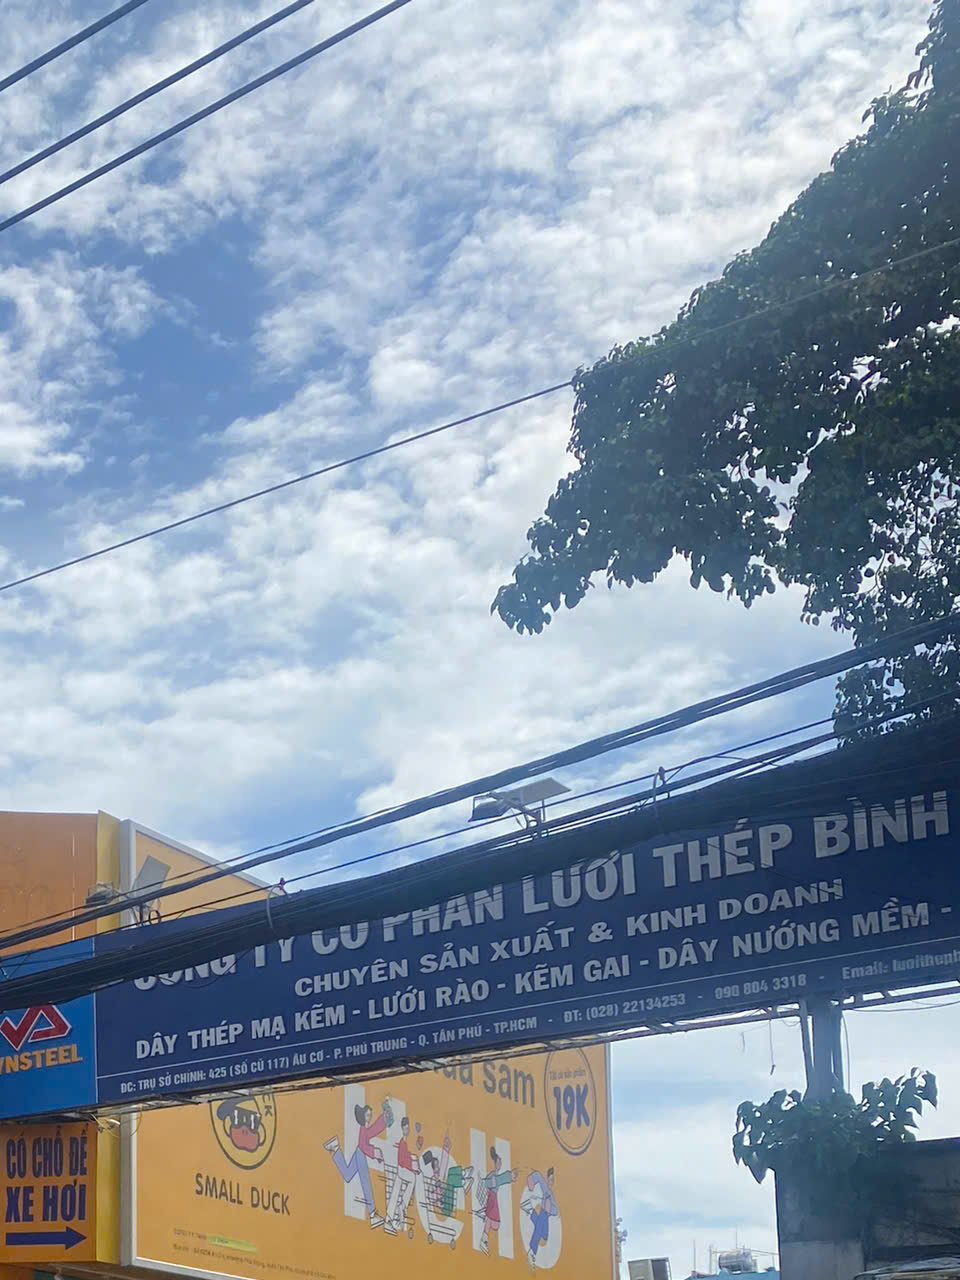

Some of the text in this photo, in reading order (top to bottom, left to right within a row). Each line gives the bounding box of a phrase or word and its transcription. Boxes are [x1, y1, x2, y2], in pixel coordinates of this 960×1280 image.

[652, 818, 793, 889] THÉP
[813, 790, 949, 859] BÌNH
[295, 878, 845, 998] CHUYÊN SẢN XUẤT & KINH DOANH
[136, 1032, 178, 1059] DÂY
[188, 1020, 244, 1050] THÉP
[251, 1015, 286, 1041] MẠ
[295, 1003, 346, 1033] KẼM
[368, 985, 427, 1020] LƯỚI
[435, 978, 490, 1008] RÀO
[514, 963, 574, 995] KẼM
[583, 954, 631, 983] GAI
[658, 937, 719, 970] DÂY
[732, 917, 840, 958] NƯỚNG
[852, 896, 930, 938] MỀM
[138, 1076, 156, 1091] TRỤ
[208, 1065, 227, 1078] 425
[267, 1056, 289, 1070] 117)
[334, 1047, 343, 1060] P.
[370, 1037, 408, 1054] TRUNG
[418, 1034, 430, 1046] Q.
[493, 1016, 538, 1034] TP.HCM
[586, 1003, 619, 1021] (028)
[623, 993, 686, 1014] 22134253
[743, 980, 768, 995] 804
[772, 974, 807, 991] 3318
[553, 1083, 590, 1130] 19K
[6, 1130, 27, 1179] CÓ
[5, 1179, 87, 1223] XE HƠI
[195, 1172, 290, 1216] SMALL DUCK
